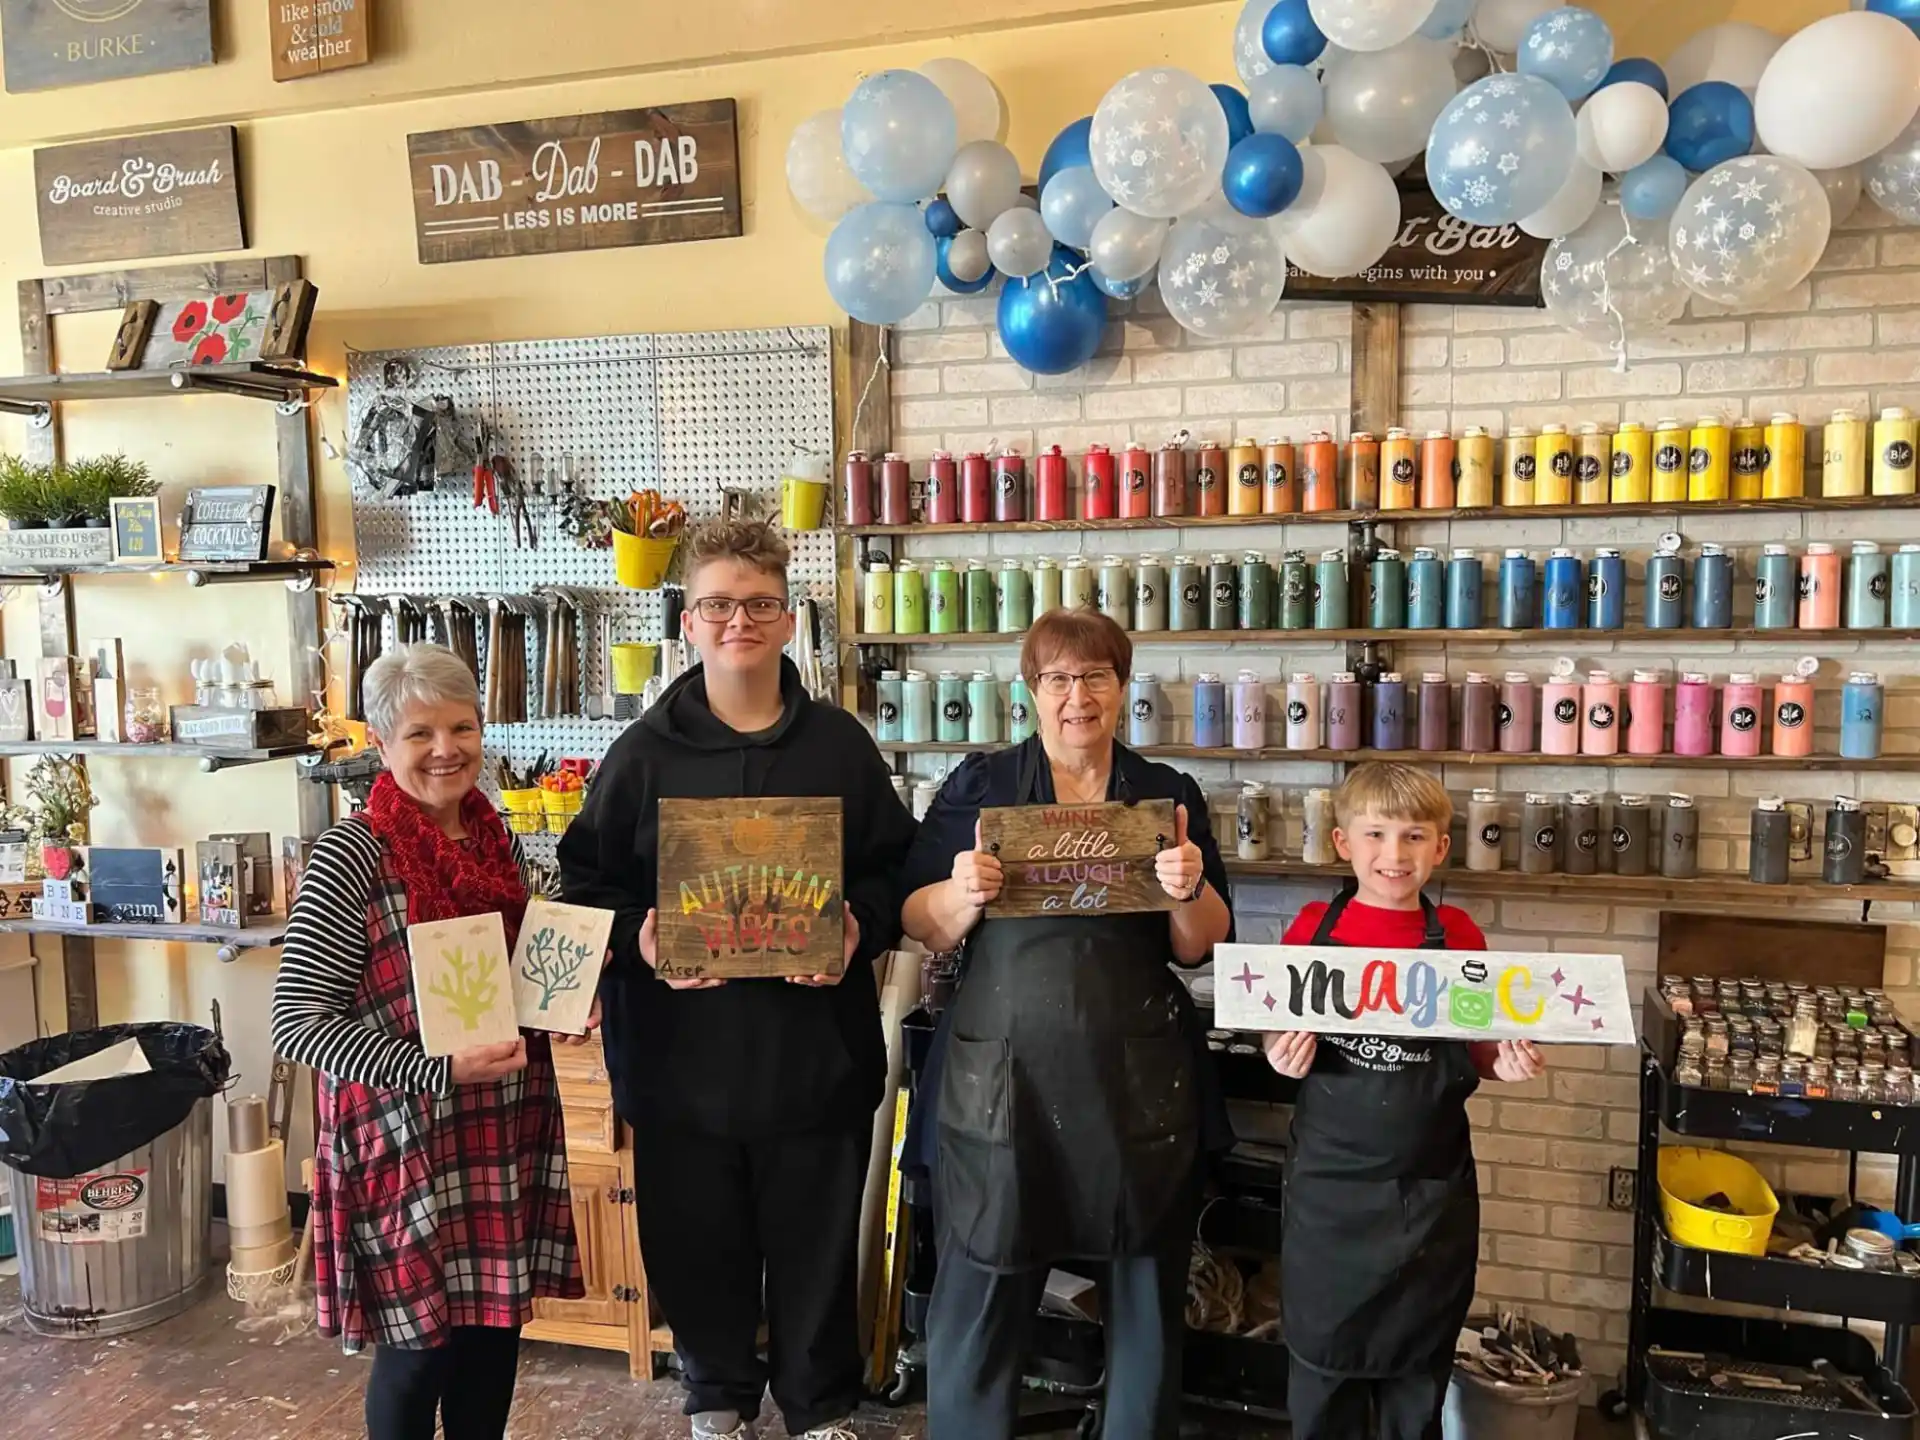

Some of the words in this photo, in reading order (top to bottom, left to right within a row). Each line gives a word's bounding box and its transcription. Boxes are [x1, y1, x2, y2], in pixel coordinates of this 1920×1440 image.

[280, 4, 309, 23] like
[313, 0, 355, 15] snow
[290, 23, 307, 44] &
[310, 15, 343, 37] cold
[67, 33, 144, 62] BURKE
[287, 37, 352, 64] weather
[49, 171, 119, 204] Board
[121, 156, 155, 198] &
[152, 159, 223, 193] Brush
[431, 159, 503, 206] DAB
[532, 136, 601, 203] Dab
[634, 135, 698, 188] DAB
[93, 203, 141, 216] creative
[144, 196, 183, 214] studio
[503, 208, 550, 231] LESS
[556, 206, 575, 226] IS
[581, 201, 638, 224] MORE
[1359, 264, 1404, 282] egins
[1409, 264, 1447, 280] with
[1453, 269, 1484, 284] you
[197, 501, 231, 520] COFFEE
[8, 533, 99, 545] FARMHOUSE
[193, 526, 248, 545] COCKTAILS
[29, 547, 79, 559] FRESH
[1042, 809, 1101, 827] WINE
[1028, 844, 1048, 859] a
[1053, 831, 1120, 859] little
[1024, 868, 1040, 884] &
[1044, 863, 1125, 884] LAUGH
[47, 885, 68, 899] BE
[679, 865, 832, 916] AUTUMN
[1042, 895, 1063, 910] a
[1069, 883, 1108, 910] lot
[34, 902, 84, 920] MINE
[1325, 1035, 1358, 1050] oard
[1358, 1036, 1386, 1059] &
[1382, 1044, 1432, 1063] Brush
[1372, 1063, 1401, 1072] studio
[87, 1183, 139, 1198] BEHRENS
